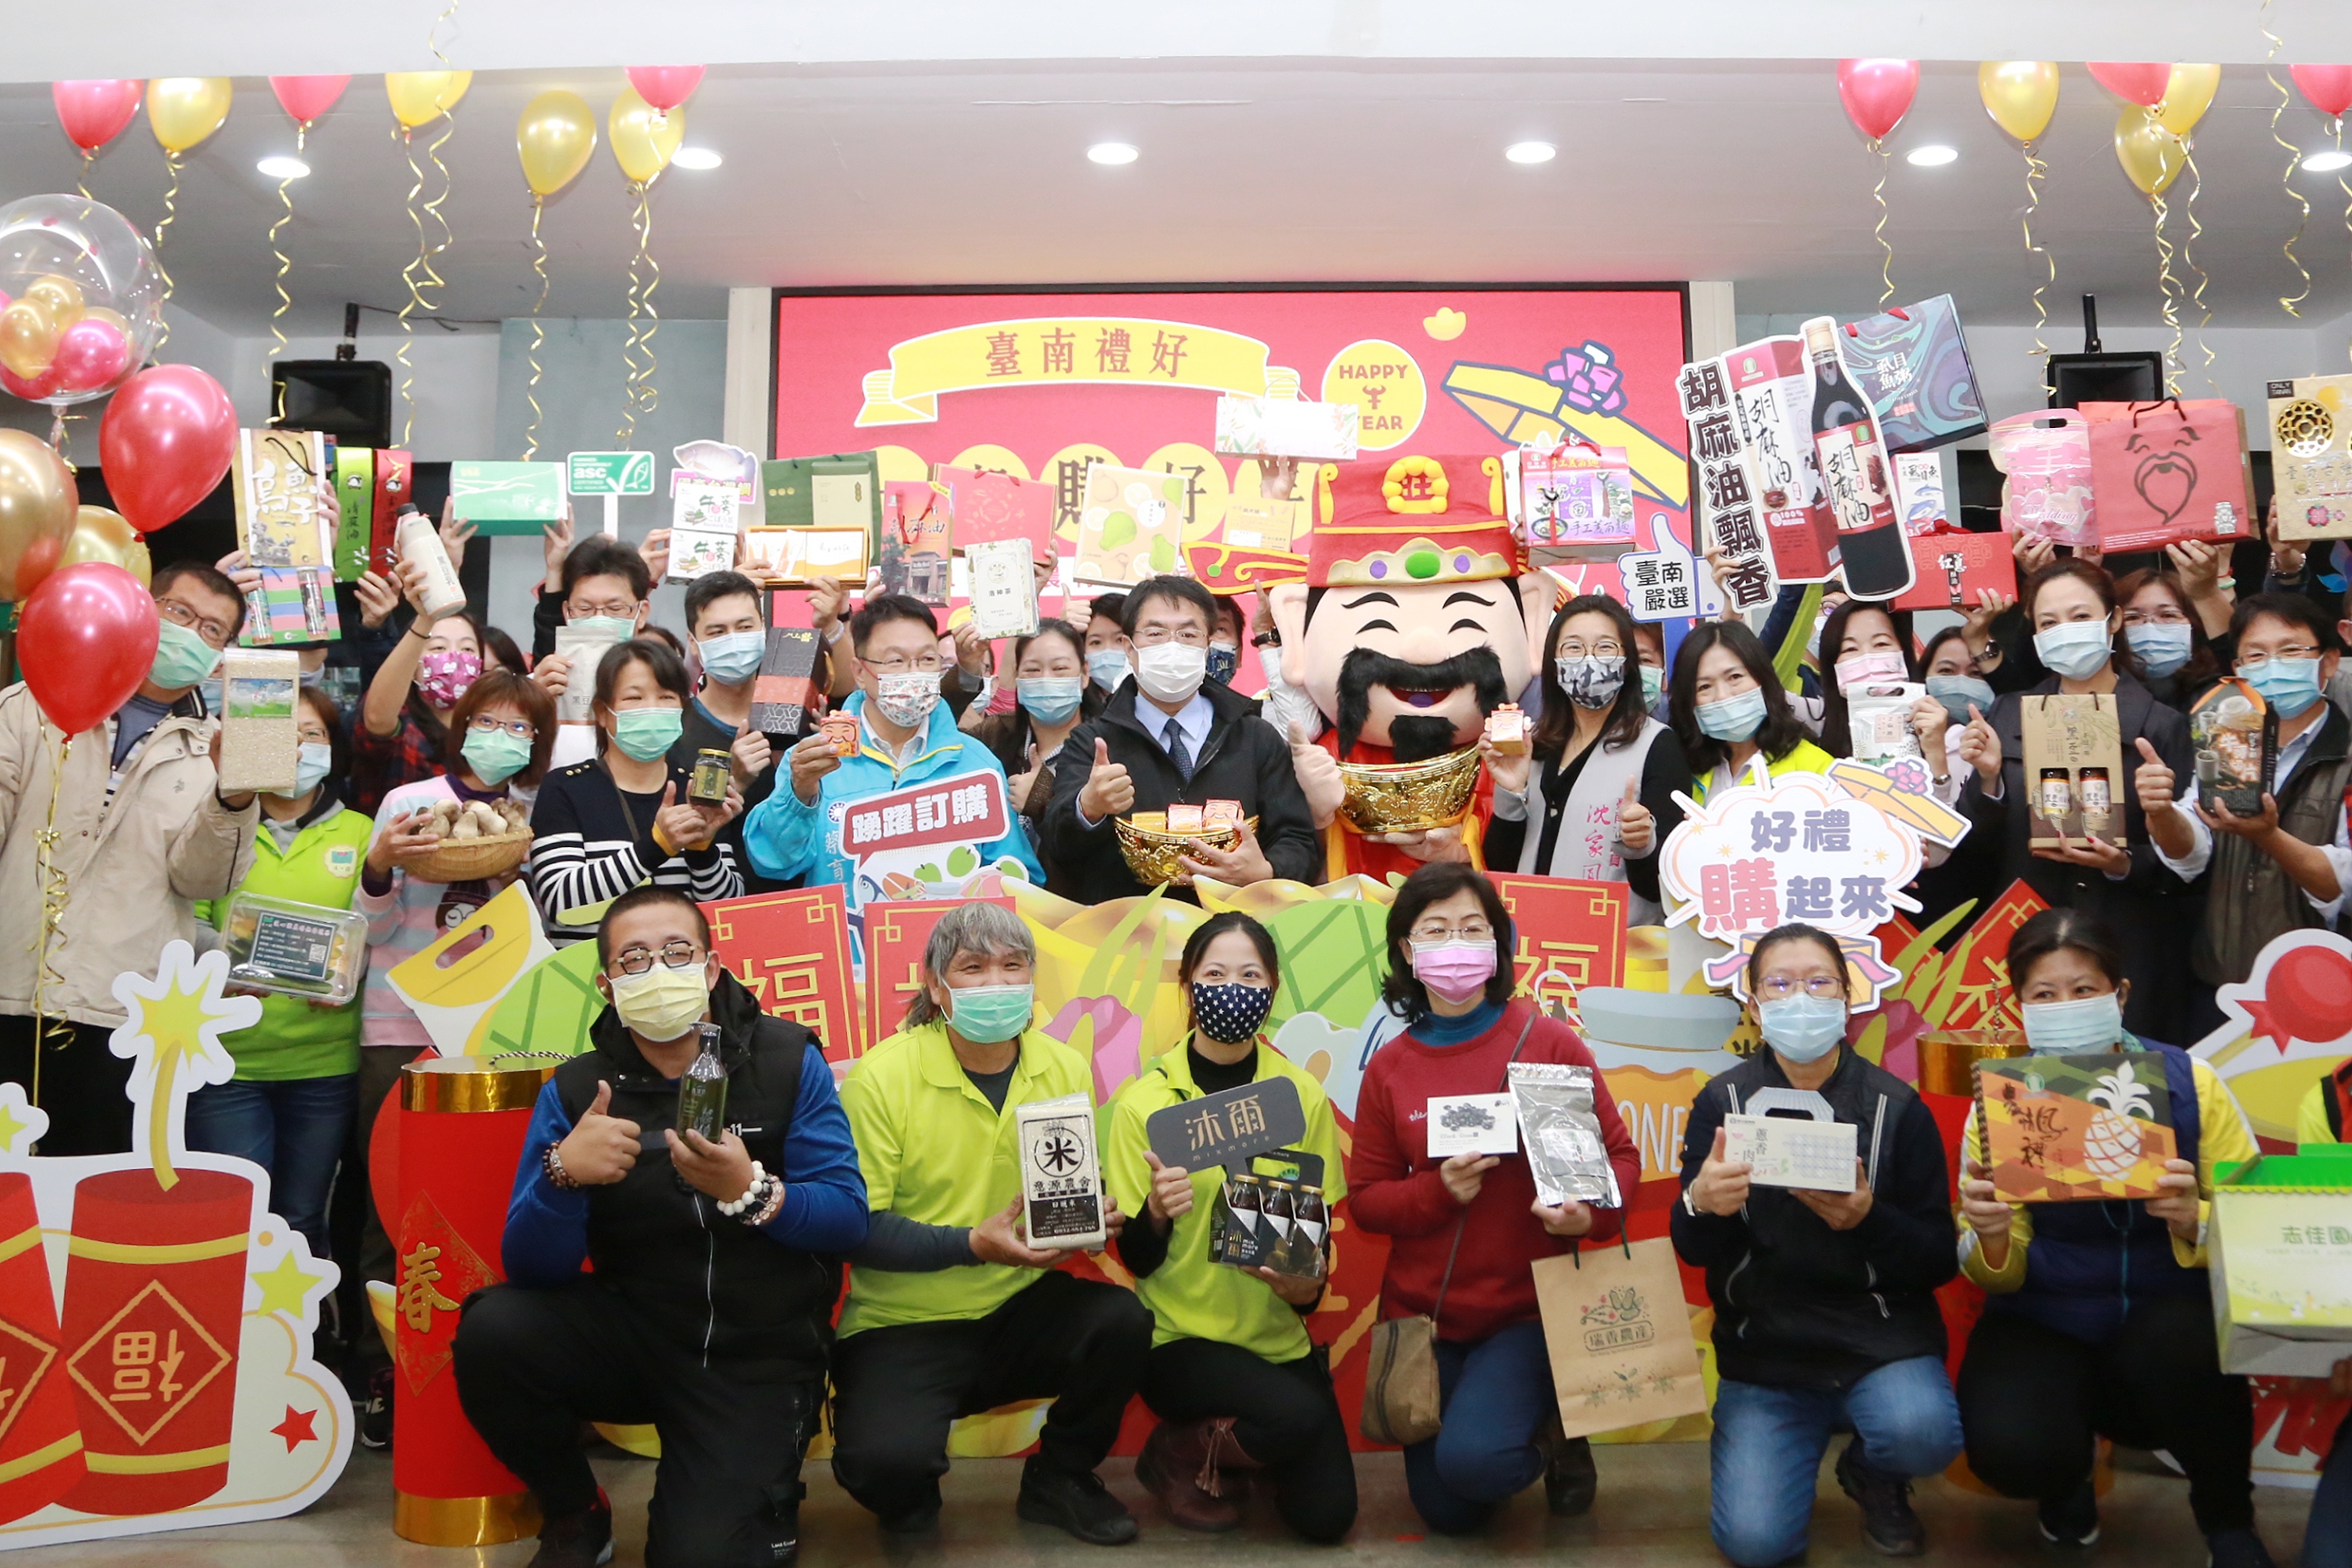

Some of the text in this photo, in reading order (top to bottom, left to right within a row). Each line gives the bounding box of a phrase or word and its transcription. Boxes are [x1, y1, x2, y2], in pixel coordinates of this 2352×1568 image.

[985, 326, 1189, 378] 臺南禮好
[1339, 364, 1409, 379] HAPPY
[1358, 414, 1403, 430] EAR
[573, 467, 607, 479] asc
[1683, 367, 1769, 606] 胡麻油飄香
[1635, 560, 1683, 587] 臺南
[1645, 586, 1689, 611] 嚴選
[852, 783, 989, 845] 踴躍訂購
[1750, 809, 1852, 854] 好禮
[1700, 857, 1888, 933] 購起來
[1185, 1094, 1266, 1151] 沐爾
[1043, 1136, 1079, 1172] 米
[396, 1241, 462, 1334] 春
